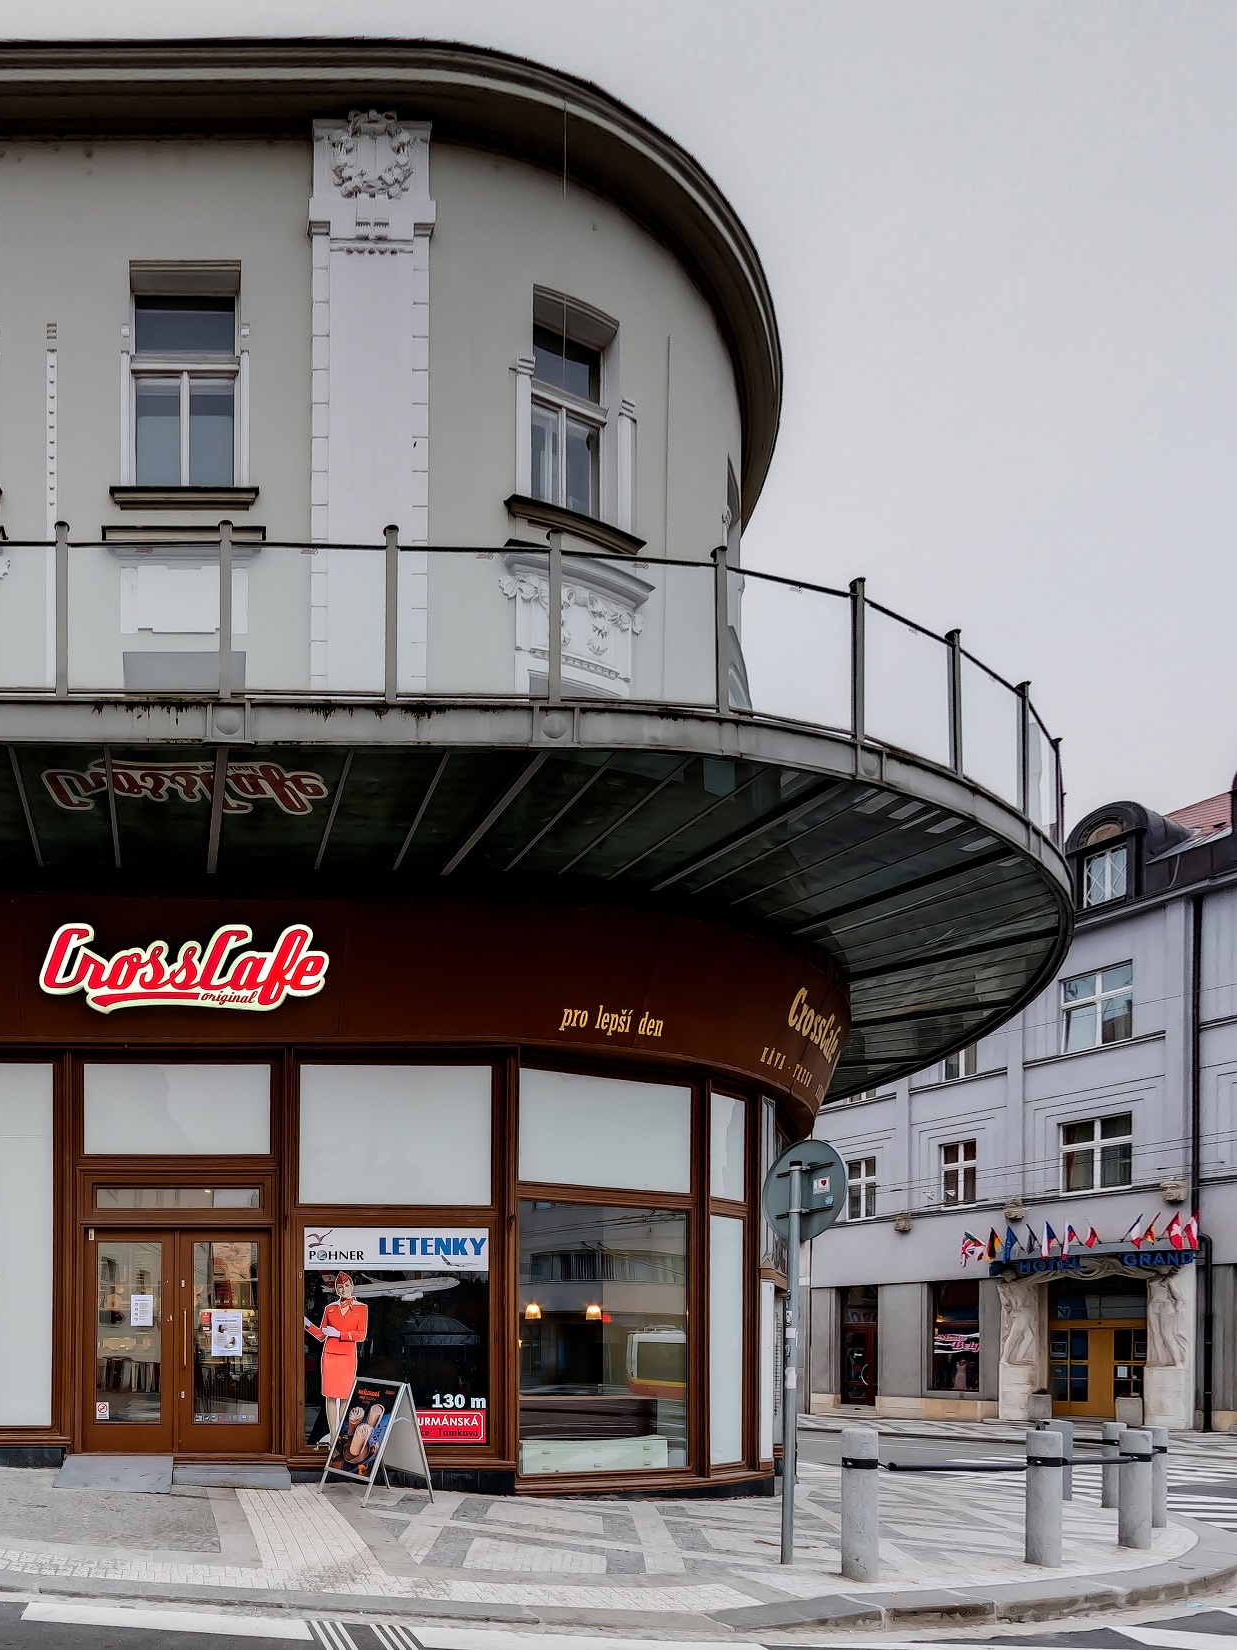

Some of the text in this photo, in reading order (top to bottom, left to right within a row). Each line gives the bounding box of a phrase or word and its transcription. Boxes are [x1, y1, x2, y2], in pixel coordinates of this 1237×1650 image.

[42, 926, 327, 1006] CrossCafe
[200, 990, 258, 1005] original
[559, 1005, 664, 1037] pro lepší den
[788, 987, 841, 1064] CrossCafe
[760, 1047, 786, 1070] KÁVA
[379, 1237, 487, 1256] LETENKY
[1019, 1252, 1193, 1273] HOTEL GRAND
[432, 1393, 487, 1409] 130 m
[417, 1415, 479, 1426] URMÁNSKÁ
[437, 1428, 479, 1437] Tomkova
